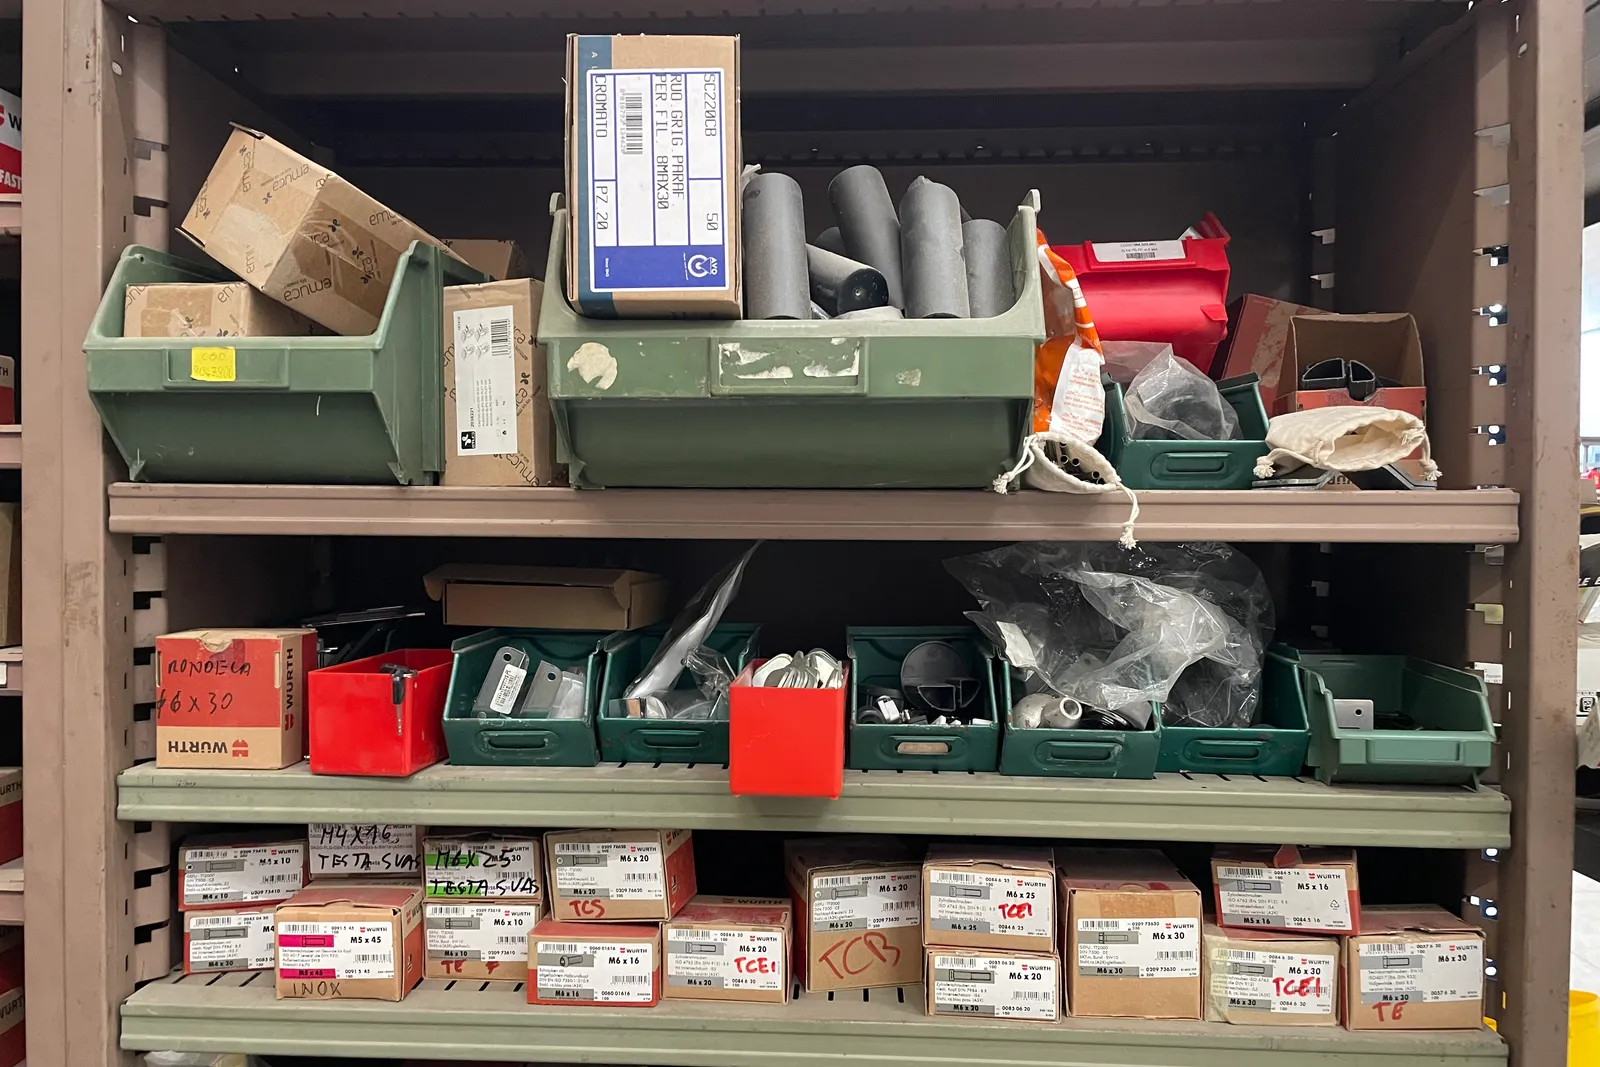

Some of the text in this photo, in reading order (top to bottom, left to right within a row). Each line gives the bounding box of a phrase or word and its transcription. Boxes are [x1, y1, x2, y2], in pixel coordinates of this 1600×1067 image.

[594, 76, 607, 138] CROMATO
[704, 74, 716, 136] SC220CB
[706, 213, 718, 230] 50
[283, 277, 332, 302] emuca
[208, 692, 233, 715] 30
[168, 740, 228, 754] WÜRTH
[318, 853, 370, 869] TESTA
[569, 899, 605, 918] TCS
[818, 931, 902, 980] TCB
[293, 981, 341, 996] INOX
[1372, 1001, 1408, 1022] TE
